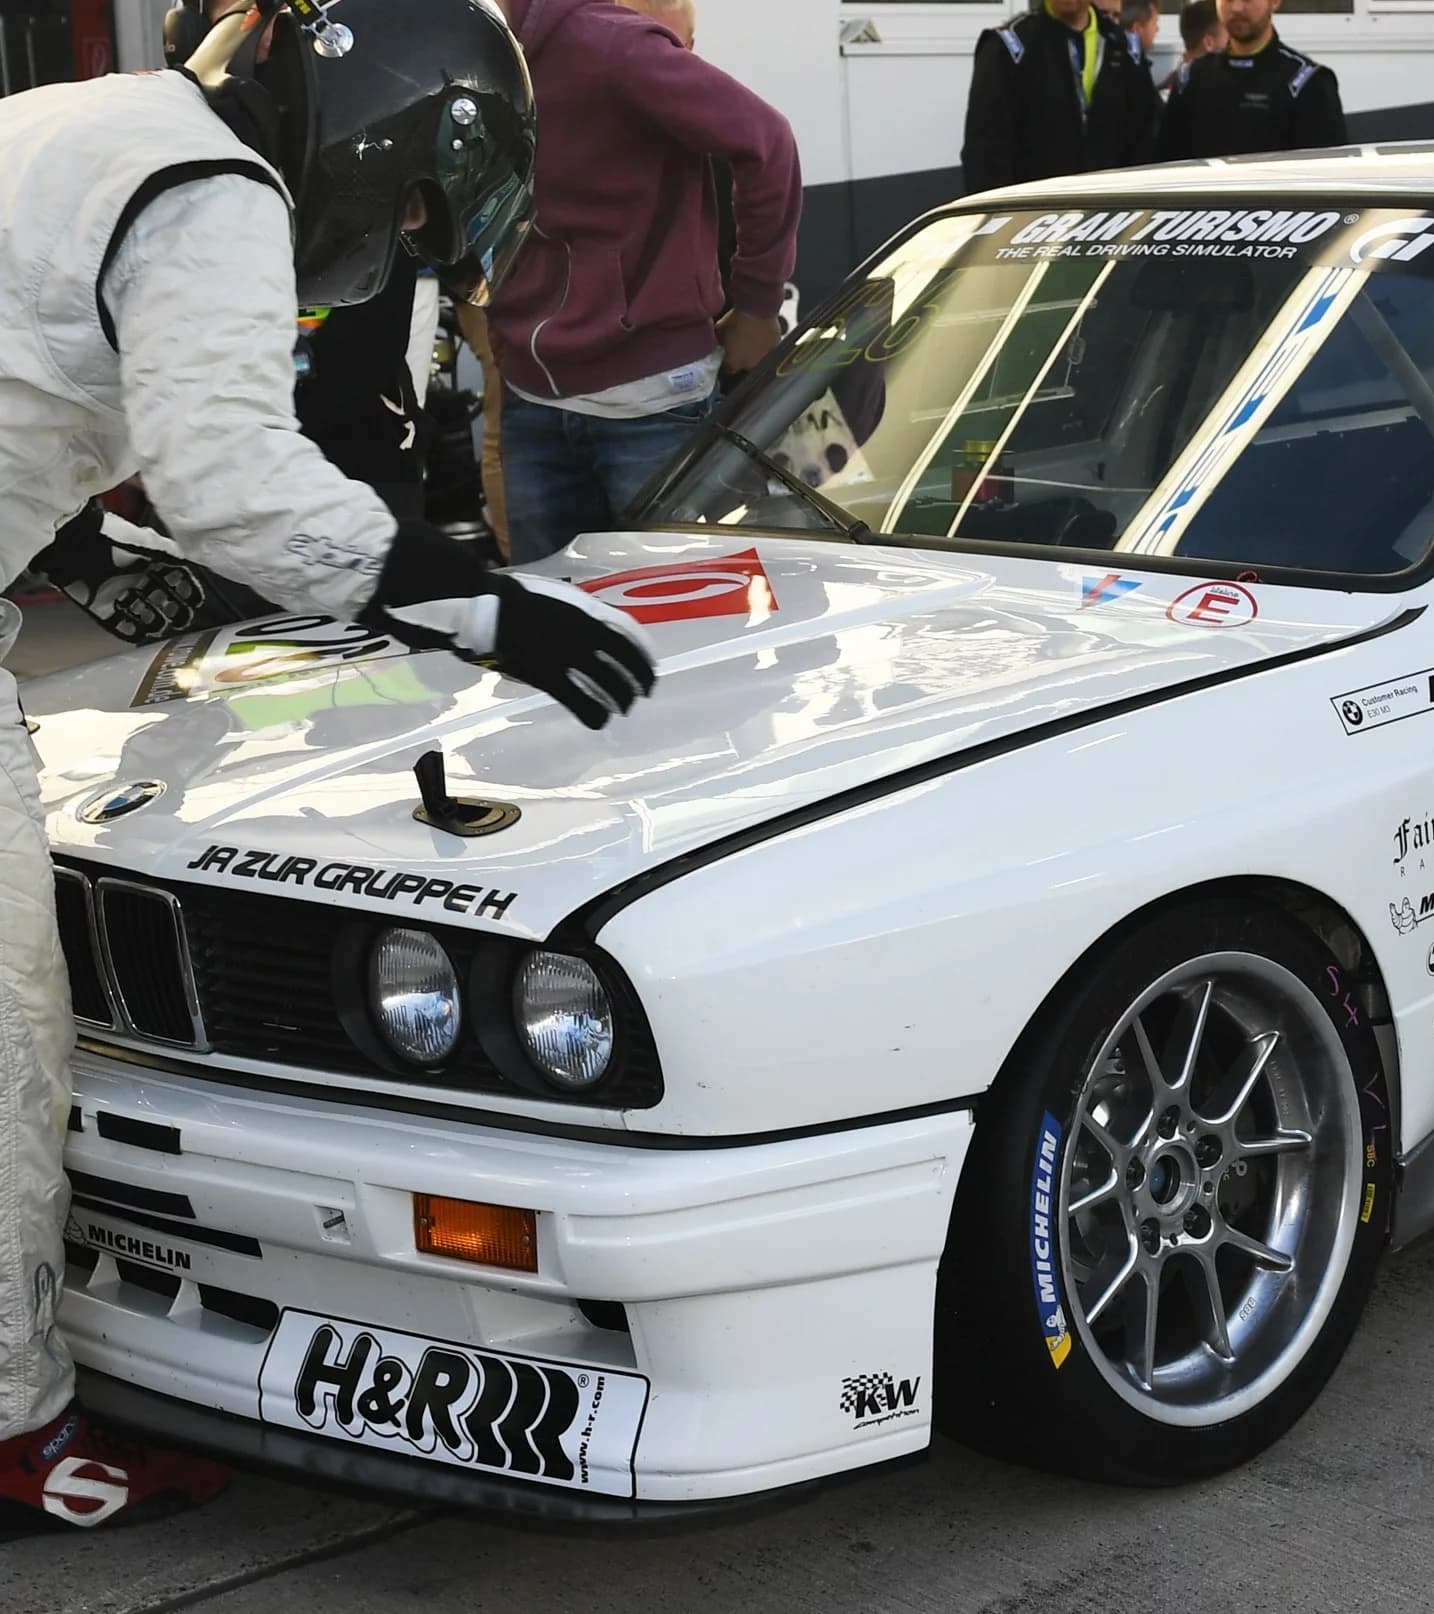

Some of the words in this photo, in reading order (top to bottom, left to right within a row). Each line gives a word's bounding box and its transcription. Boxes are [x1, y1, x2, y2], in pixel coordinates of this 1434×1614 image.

[1010, 211, 1125, 245] GRAN
[1130, 210, 1341, 244] TURISMO
[995, 247, 1031, 260] THE
[1034, 246, 1084, 259] REAL
[1086, 244, 1169, 258] DRIVING
[1172, 243, 1297, 260] SIMULATOR
[1361, 692, 1395, 707] Customer
[1394, 684, 1418, 697] Racing
[1367, 708, 1381, 719] E30
[187, 845, 239, 873] JA
[232, 851, 317, 886] ZUR
[313, 863, 484, 914] GRUPPE
[475, 889, 519, 920] H
[1035, 1130, 1058, 1304] MICHELIN
[88, 1224, 192, 1270] MICHELIN
[855, 1375, 921, 1419] KW
[579, 1375, 605, 1484] www.h-r.com
